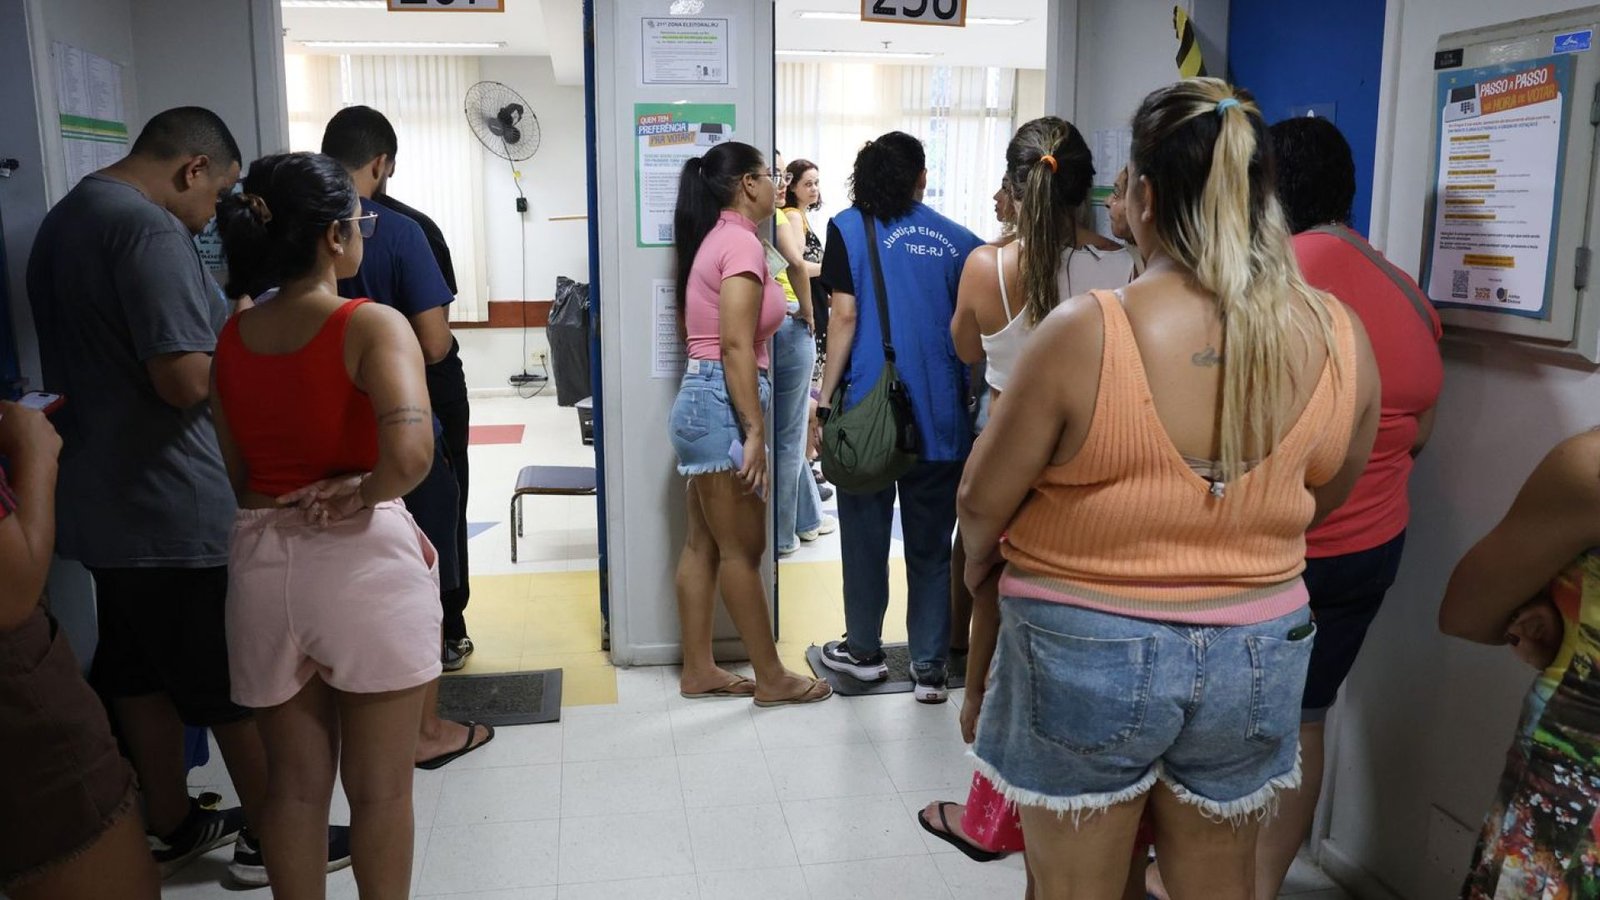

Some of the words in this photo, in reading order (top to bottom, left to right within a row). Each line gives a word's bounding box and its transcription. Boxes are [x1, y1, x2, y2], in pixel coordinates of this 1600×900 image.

[1480, 79, 1508, 97] PASSO
[1514, 68, 1548, 90] PASSO
[1493, 93, 1517, 110] HORA
[1527, 83, 1555, 103] VOTAR
[640, 116, 657, 125] QUEM
[657, 115, 669, 123] TEM
[638, 122, 687, 134] PREFERÊNCIA
[649, 134, 665, 144] PRA
[883, 225, 917, 249] Justiça
[918, 226, 959, 258] Eleitoral
[904, 242, 944, 257] TRE-RJ
